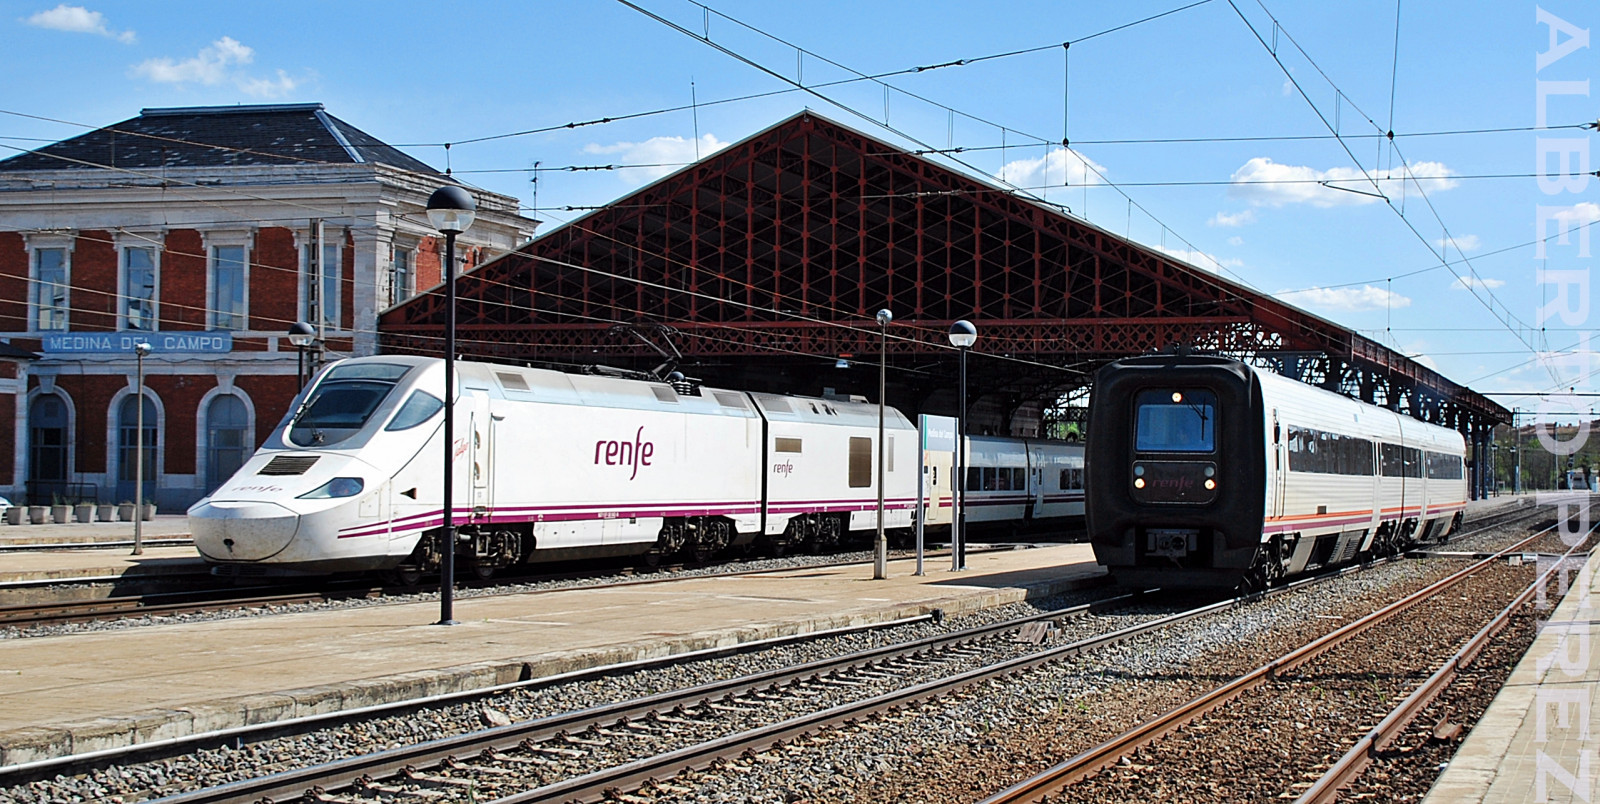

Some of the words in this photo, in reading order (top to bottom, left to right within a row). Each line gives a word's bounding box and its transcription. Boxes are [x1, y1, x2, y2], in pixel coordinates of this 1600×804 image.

[50, 336, 112, 350] MEDINA
[164, 336, 223, 350] CAMPO
[594, 425, 654, 481] renfe
[773, 459, 793, 478] renfe
[231, 485, 283, 493] renfe
[1152, 475, 1195, 492] renfe
